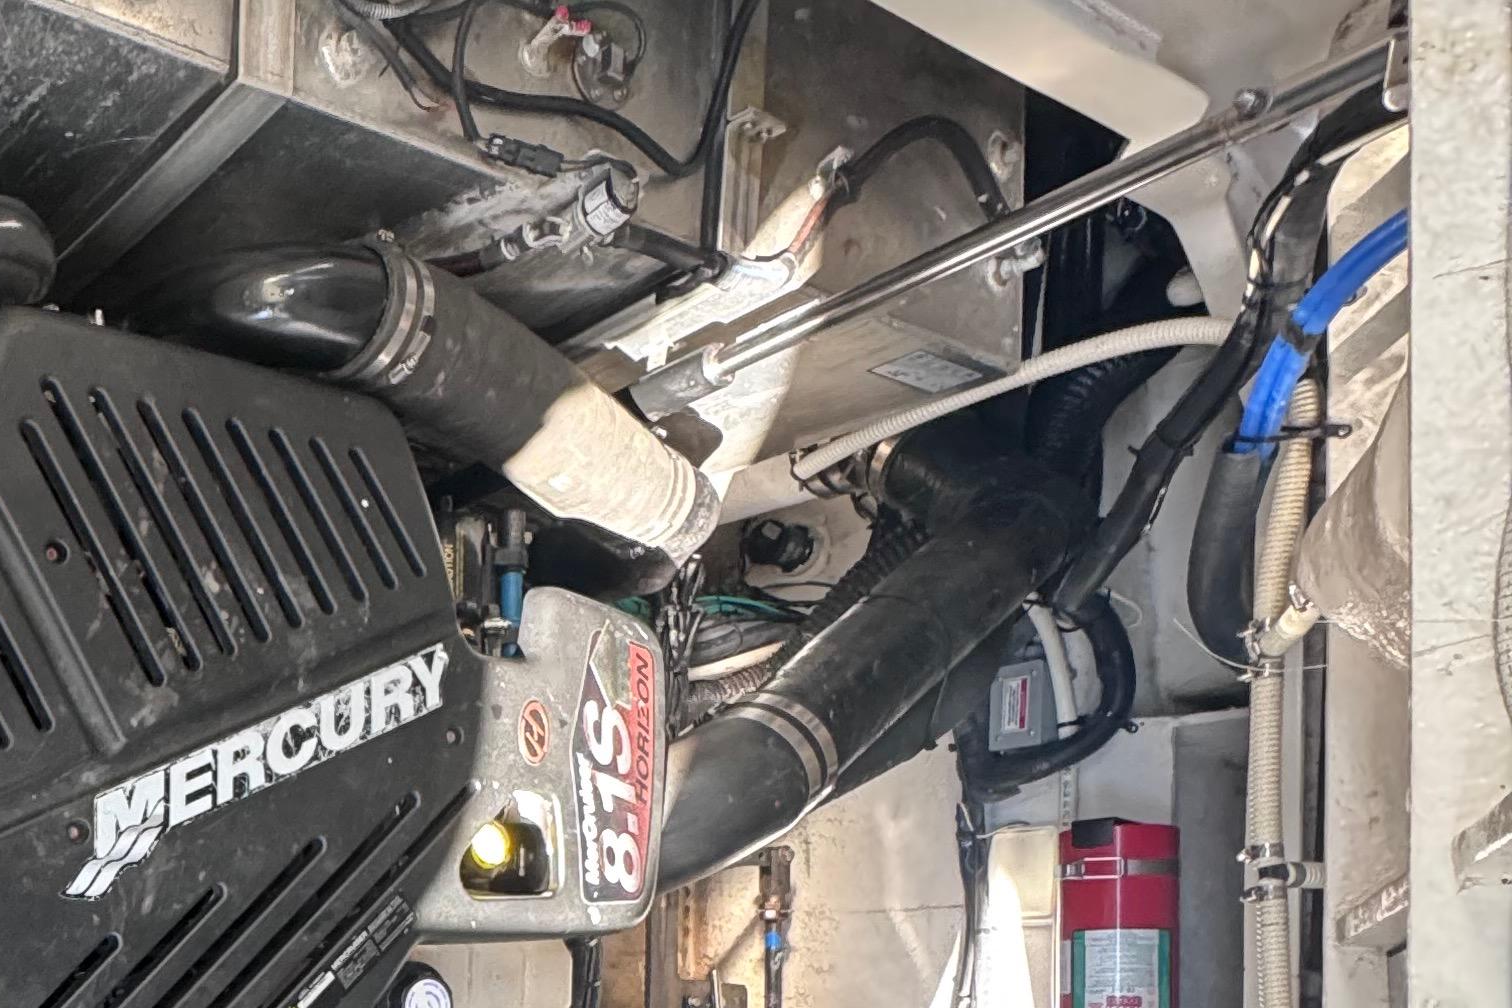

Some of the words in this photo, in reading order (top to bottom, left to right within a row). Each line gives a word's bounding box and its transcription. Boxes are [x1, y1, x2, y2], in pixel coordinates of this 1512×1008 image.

[94, 644, 448, 860] MERCURY
[583, 699, 641, 893] 8.1S
[634, 652, 650, 807] HORIZON
